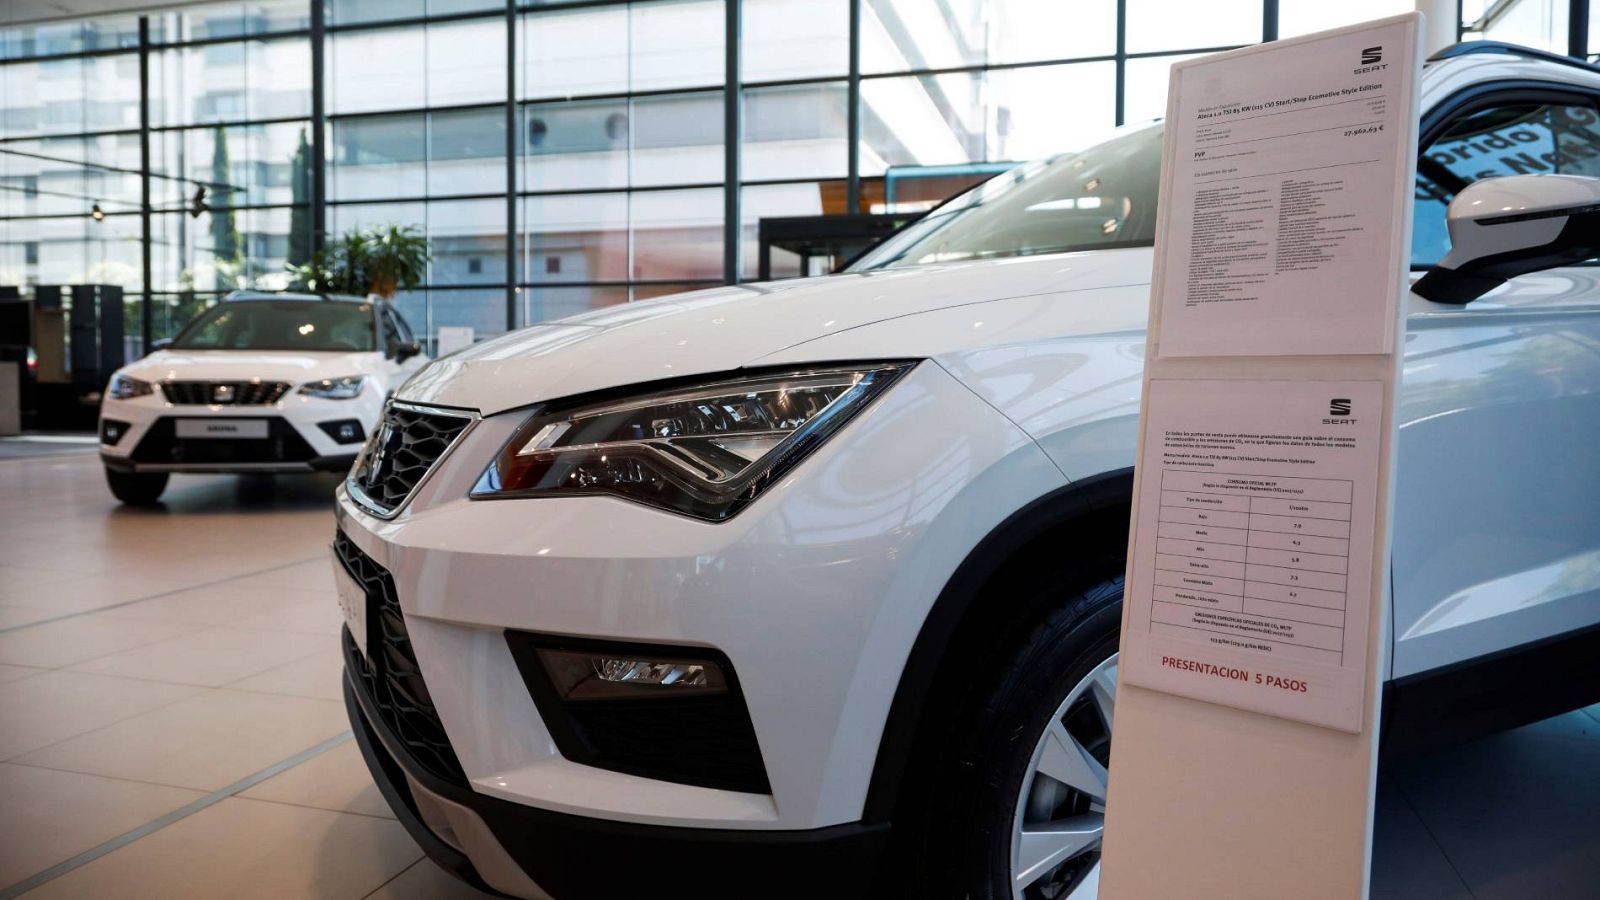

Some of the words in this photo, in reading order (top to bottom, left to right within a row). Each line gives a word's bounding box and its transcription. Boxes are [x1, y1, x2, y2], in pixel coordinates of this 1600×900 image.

[1353, 63, 1389, 75] SEAT
[1264, 101, 1275, 109] CV)
[1276, 96, 1308, 106] Start/Stop
[1309, 90, 1340, 101] Ecomotive
[1341, 87, 1359, 96] Style
[1359, 83, 1383, 92] Edition
[1194, 151, 1206, 159] PVP
[1161, 656, 1249, 682] PRESENTACION
[1255, 673, 1264, 685] 5
[1266, 674, 1308, 693] PASOS
